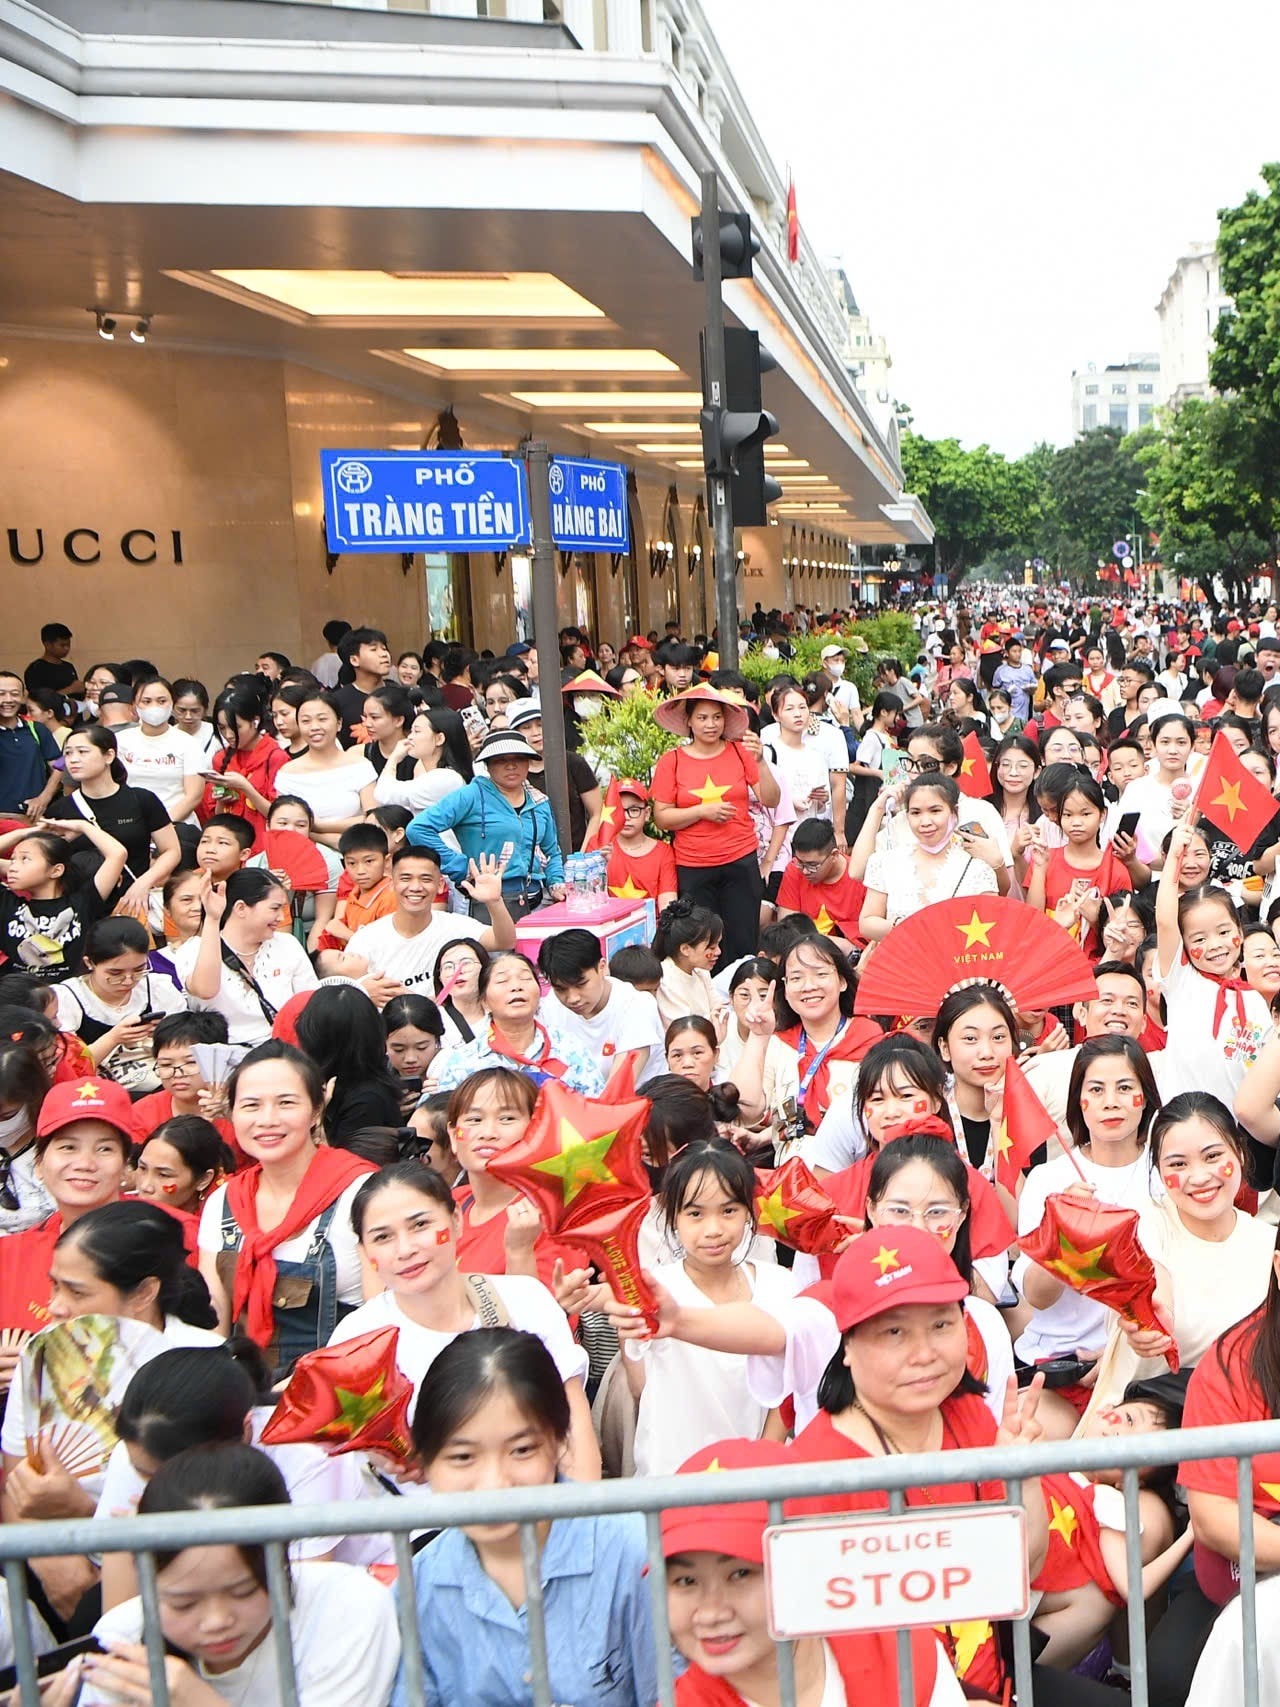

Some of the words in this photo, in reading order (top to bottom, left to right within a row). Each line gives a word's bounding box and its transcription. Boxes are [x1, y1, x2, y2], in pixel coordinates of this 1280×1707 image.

[415, 460, 476, 486] PHỐ
[580, 471, 607, 493] PHỐ
[344, 501, 445, 538] TRÀNG
[451, 491, 514, 536] TIỀN
[552, 499, 596, 537] HÀNG
[598, 503, 624, 538] BÀI
[7, 528, 185, 567] UCCI
[953, 953, 978, 965] VIỆT
[980, 951, 1004, 961] NAM
[606, 1242, 628, 1271] LOVE
[468, 1274, 501, 1326] Christian
[840, 1530, 953, 1556] POLICE
[825, 1566, 972, 1610] STOP
